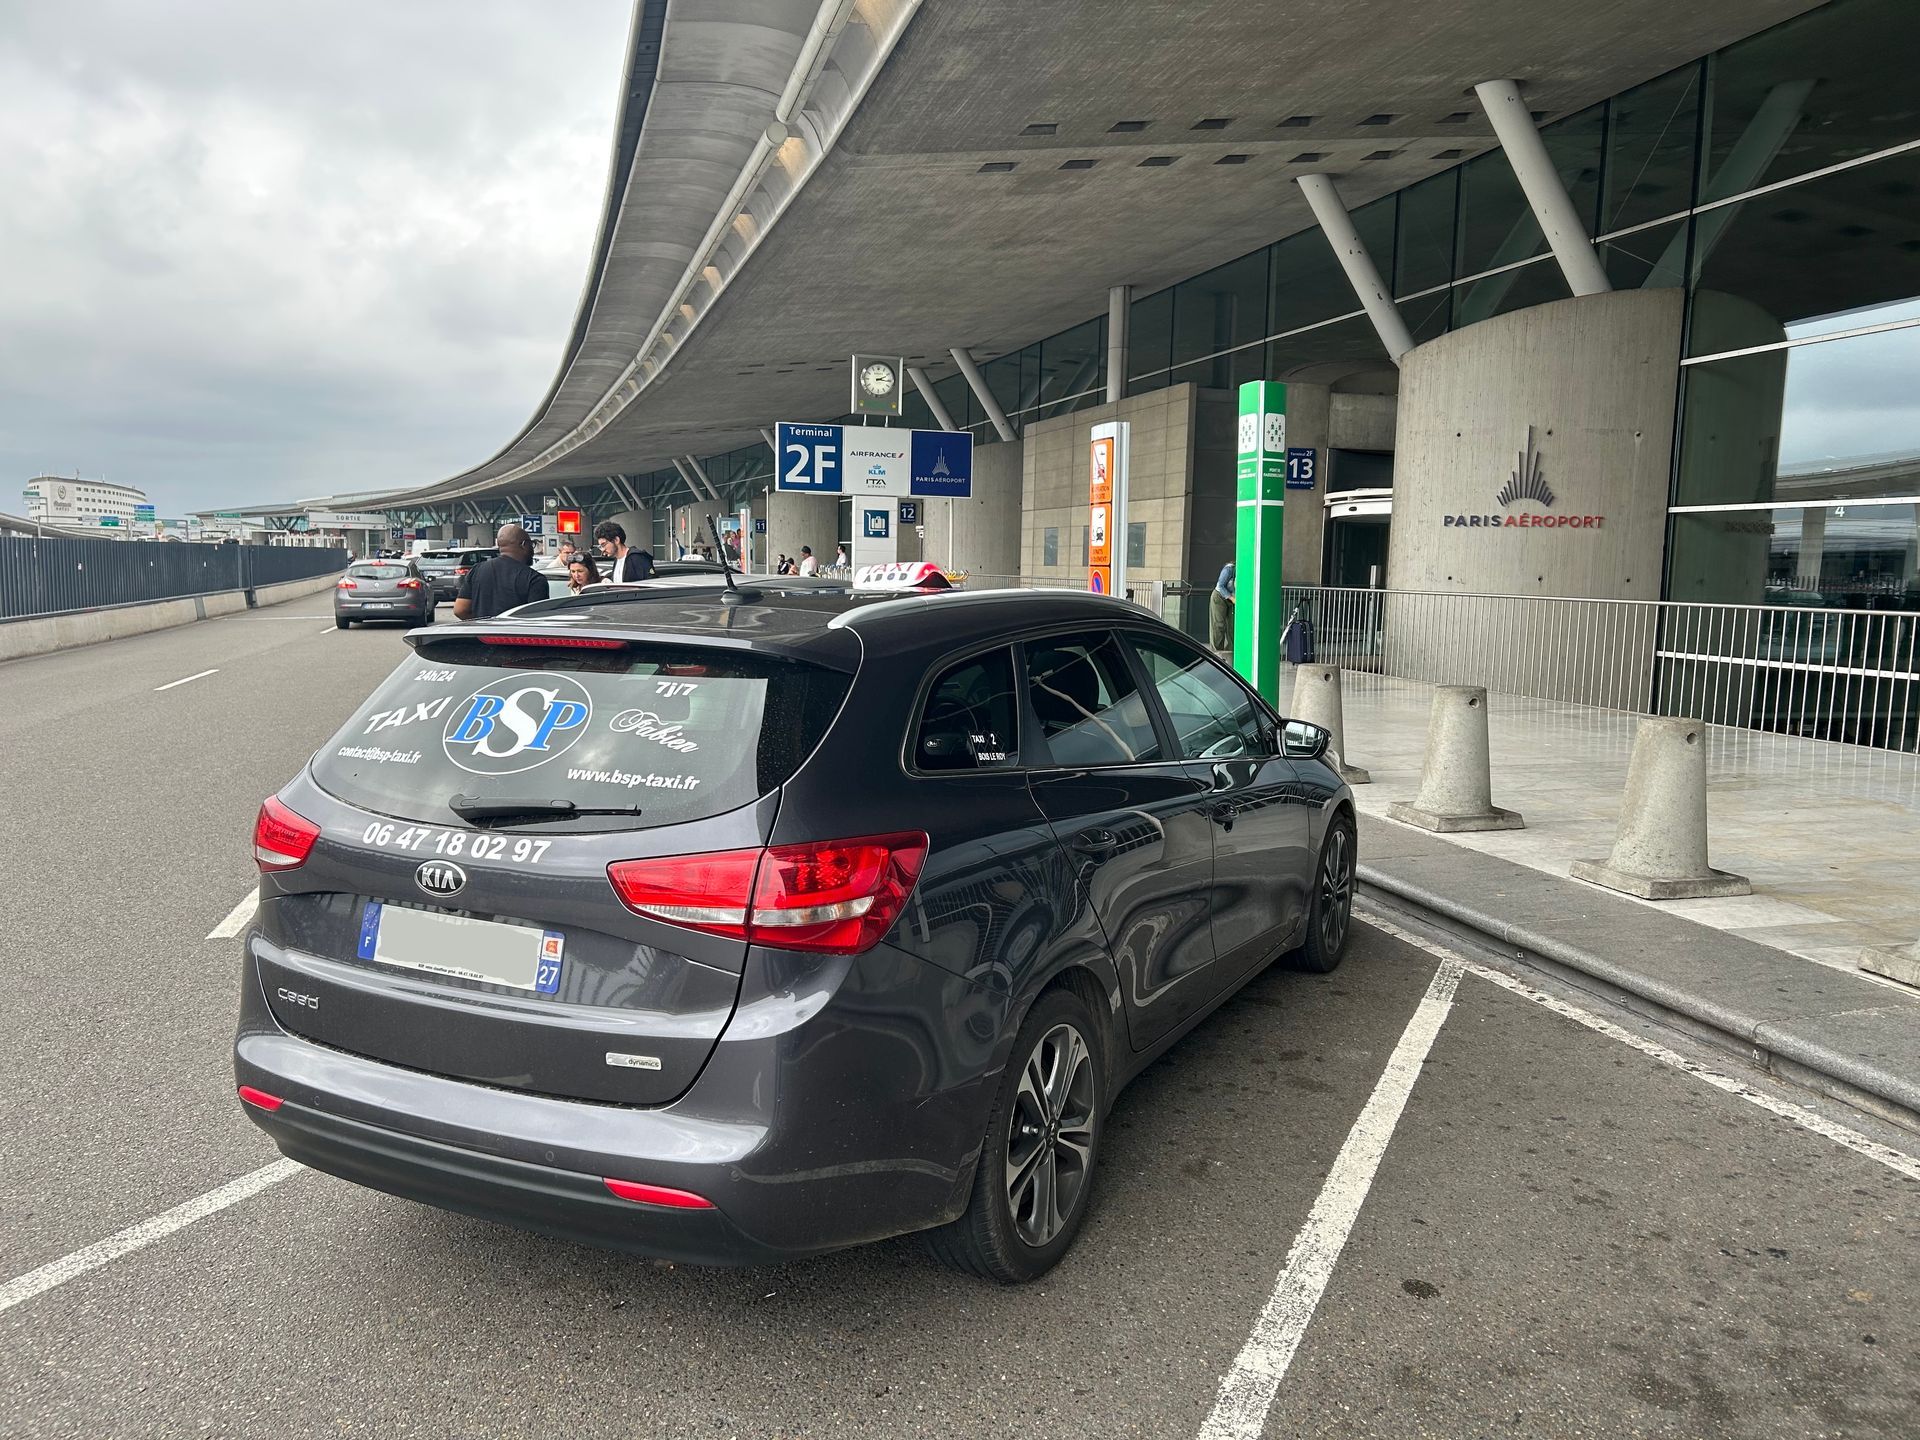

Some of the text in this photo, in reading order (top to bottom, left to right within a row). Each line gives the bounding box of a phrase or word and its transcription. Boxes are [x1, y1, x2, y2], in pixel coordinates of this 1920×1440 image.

[789, 426, 833, 437] Terminal
[785, 443, 836, 484] 2F
[1289, 458, 1314, 479] 13
[865, 478, 887, 486] ITA
[901, 507, 915, 519] 12
[1834, 506, 1845, 518] 4
[524, 520, 541, 533] 2F
[755, 522, 766, 530] 11
[392, 530, 403, 539] 2F
[414, 670, 457, 682] 24h/24
[655, 681, 699, 698] 7j/7
[363, 696, 453, 735] TAXI
[445, 687, 587, 758] BSP
[609, 708, 699, 753] Fabien
[990, 733, 997, 745] 2
[338, 745, 422, 764] contact@bsp-taxi.fr
[567, 768, 701, 790] www.bsp-taxi.fr
[362, 822, 552, 864] 06 47 18 02 97
[421, 866, 457, 890] KIA
[364, 936, 371, 947] F
[538, 965, 559, 986] 27
[628, 1058, 660, 1068] dynamics
